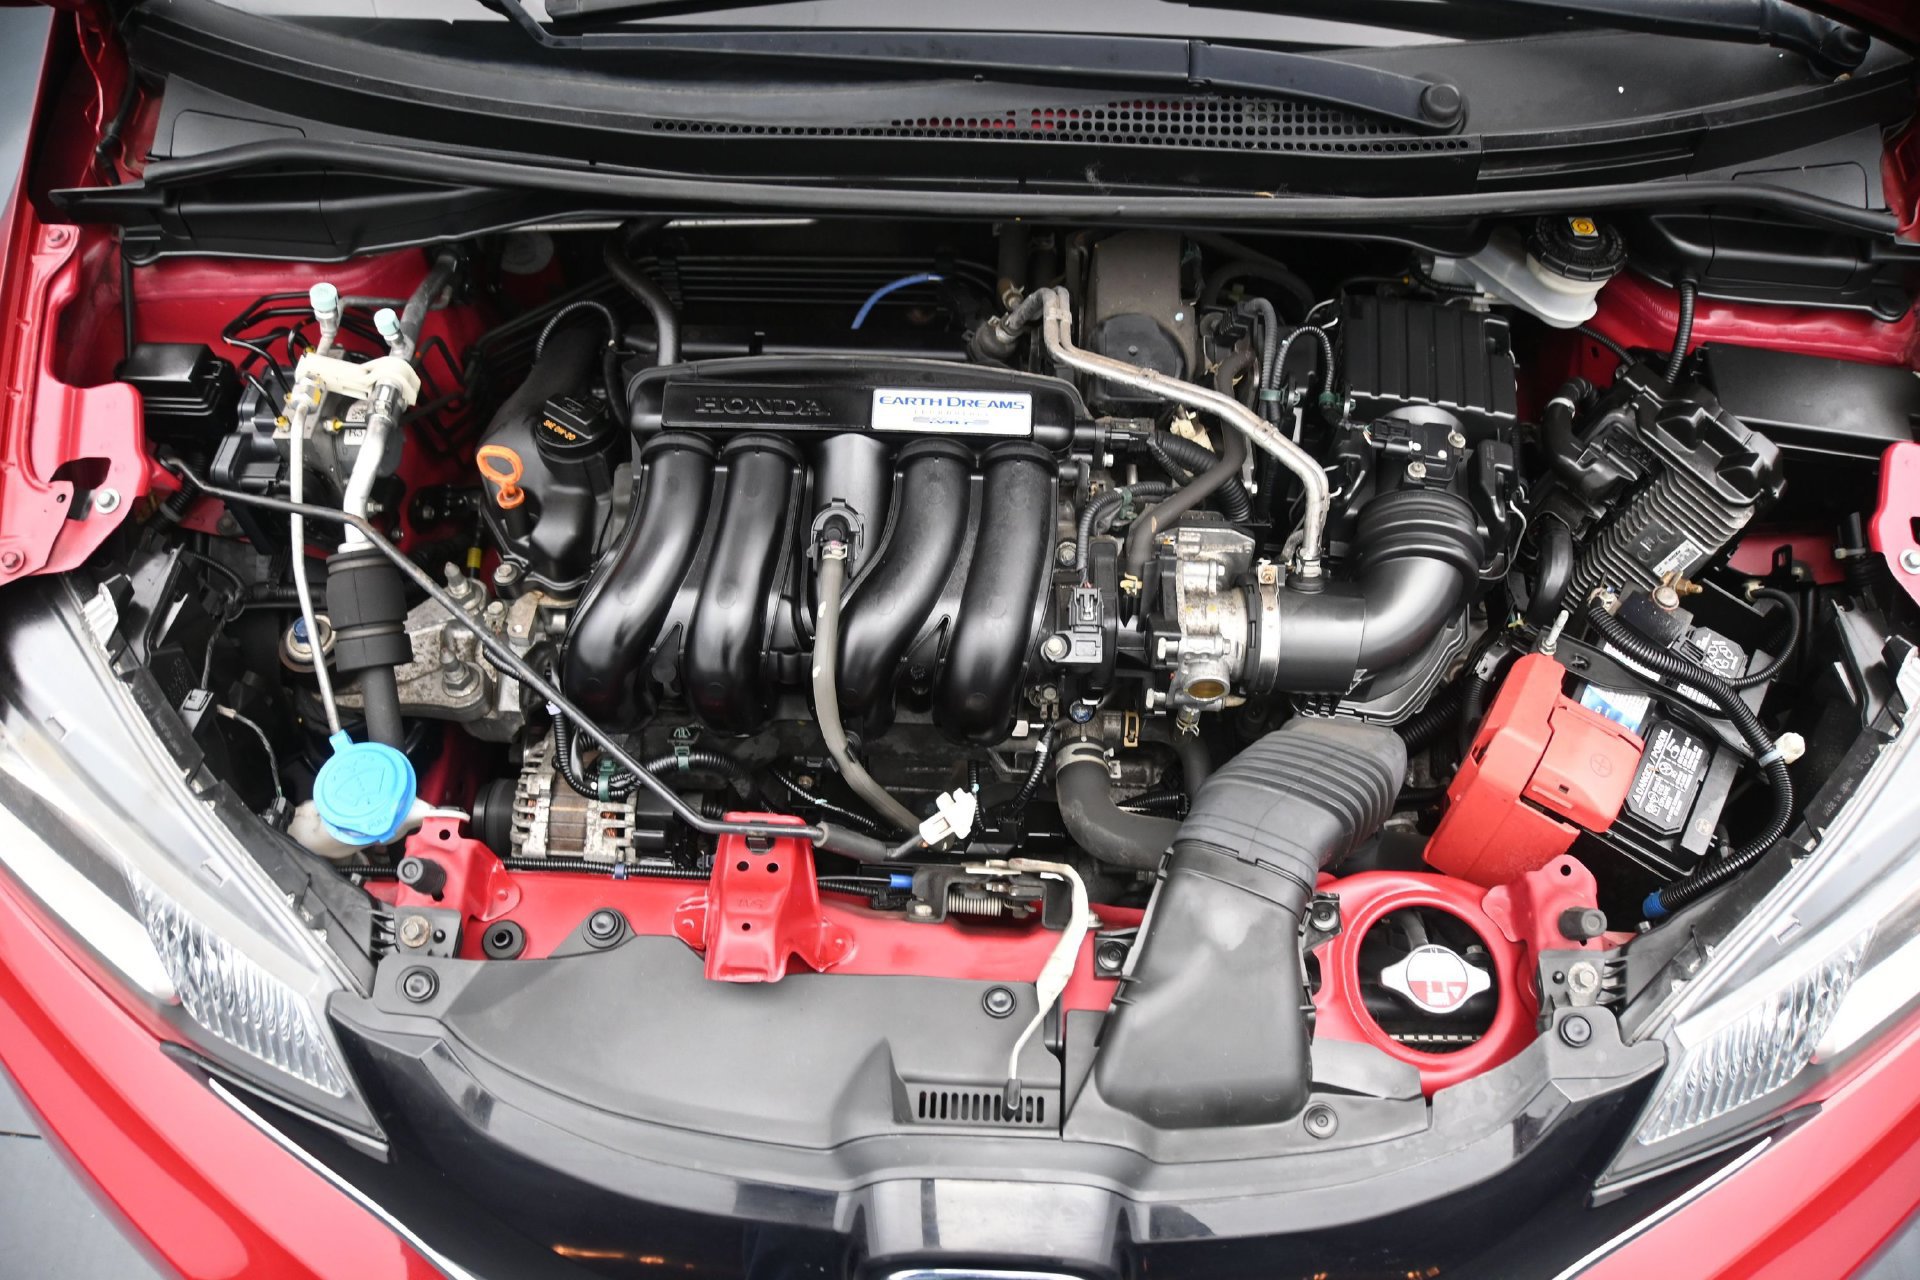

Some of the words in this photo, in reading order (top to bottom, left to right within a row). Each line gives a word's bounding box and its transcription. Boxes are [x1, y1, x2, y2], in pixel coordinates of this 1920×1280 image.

[694, 396, 831, 417] HONDA
[879, 396, 942, 407] EARTH
[946, 396, 1025, 410] DREAMS
